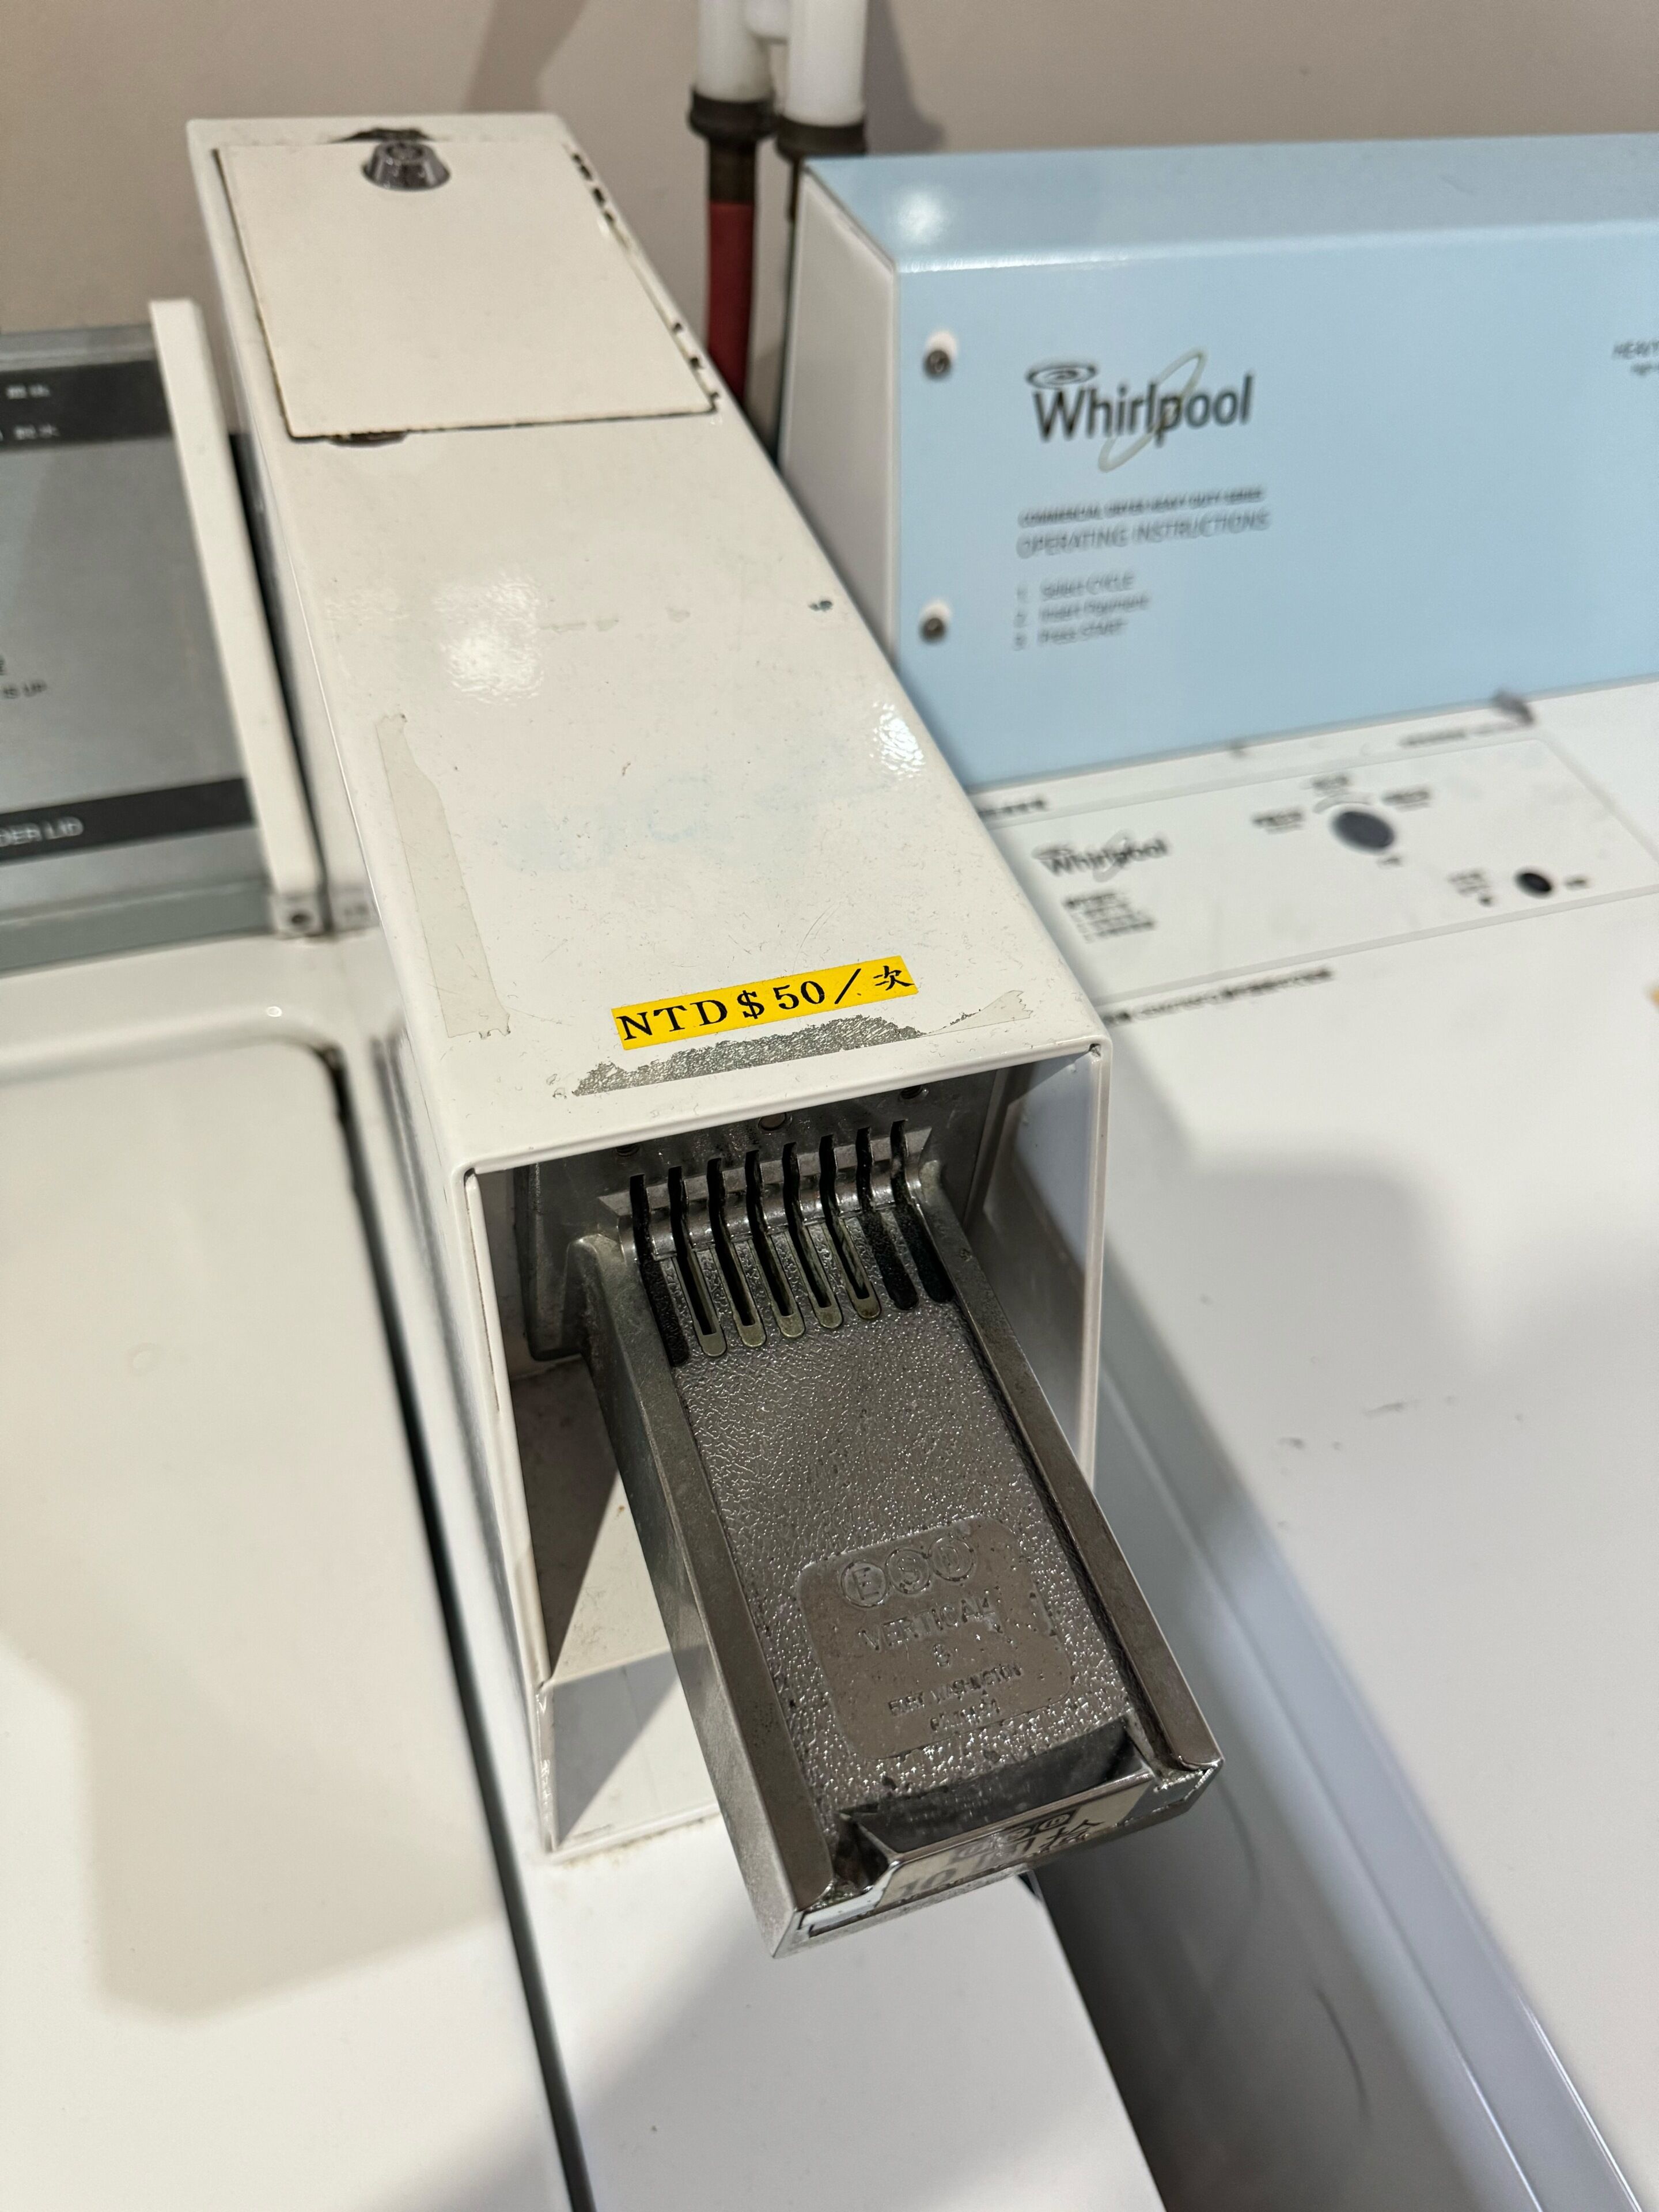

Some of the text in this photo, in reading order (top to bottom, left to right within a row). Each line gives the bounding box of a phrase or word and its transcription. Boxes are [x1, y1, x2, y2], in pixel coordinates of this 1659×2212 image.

[1032, 369, 1256, 449] Whirlpool
[1016, 525, 1130, 559] OPERATING
[1132, 507, 1271, 544] INSTRUCTIONS
[857, 1596, 1003, 1653] VERTICAL
